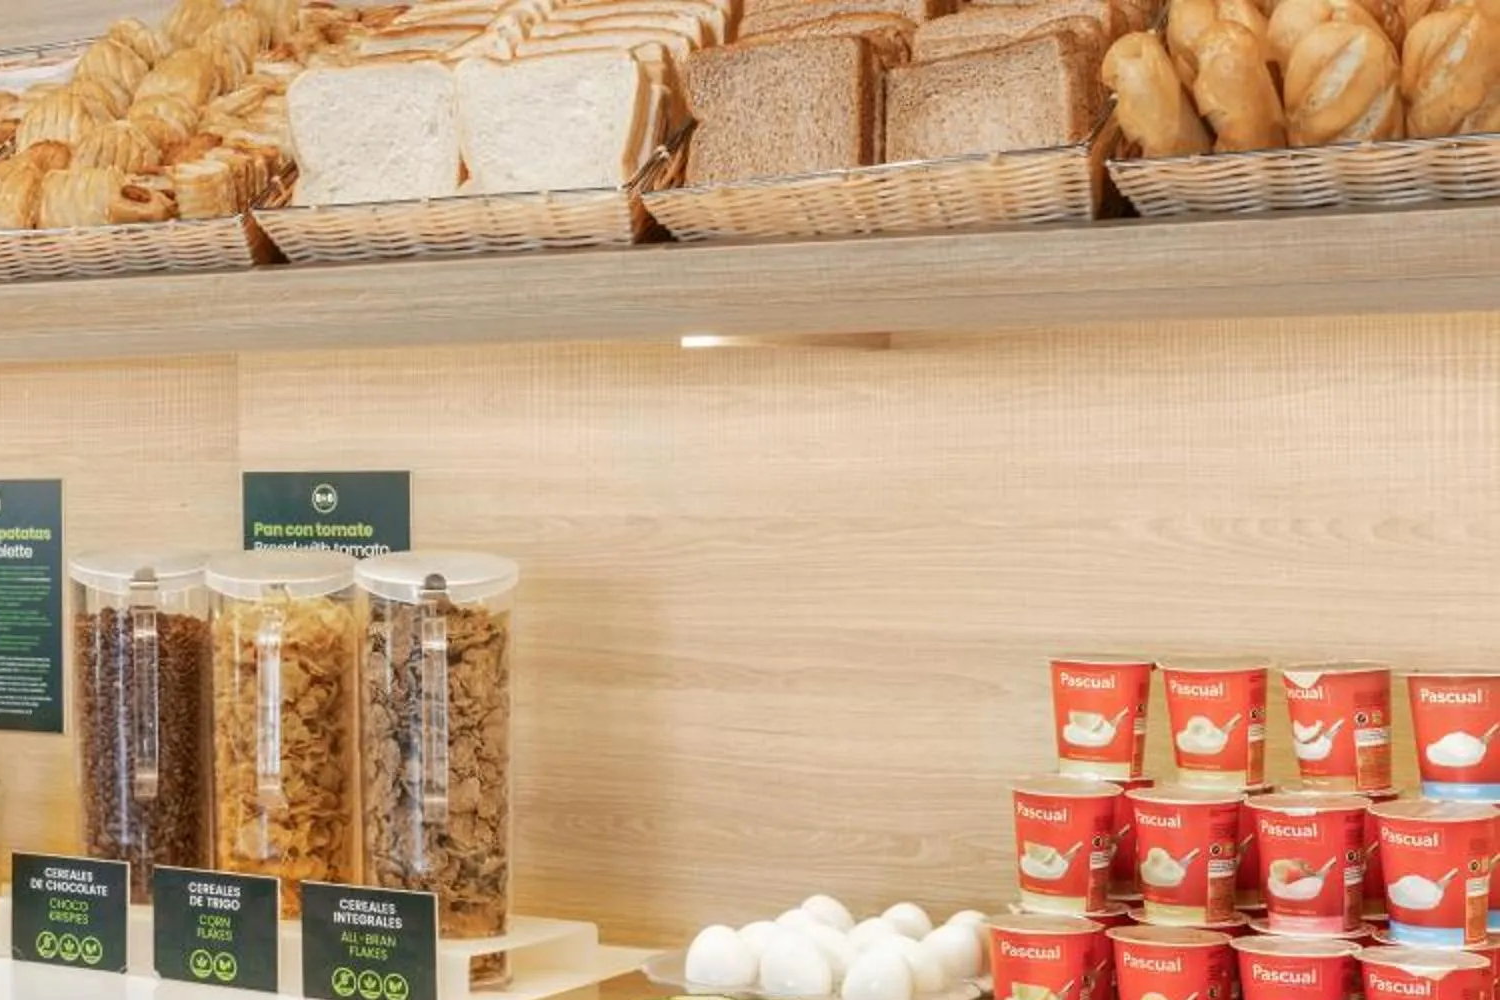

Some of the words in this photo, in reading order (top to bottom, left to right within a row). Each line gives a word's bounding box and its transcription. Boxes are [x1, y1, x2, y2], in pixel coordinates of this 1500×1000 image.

[253, 521, 283, 537] Pan
[285, 525, 314, 537] con
[315, 522, 374, 538] tomate
[1060, 671, 1116, 689] Pascual
[1170, 680, 1224, 697] Pascual
[1420, 688, 1483, 704] Pascual
[1016, 801, 1067, 822] Pascual
[1135, 807, 1181, 829] Pascual
[1260, 819, 1318, 838] Pascual
[1381, 827, 1439, 847] Pascual
[44, 867, 93, 882] CEREALES
[30, 877, 43, 889] DE
[45, 879, 109, 897] CHOCOLATE
[187, 881, 241, 897] CEREALES
[49, 898, 89, 912] CHOCO
[189, 895, 204, 907] DE
[206, 896, 241, 911] TRIGO
[339, 899, 397, 915] CEREALES
[199, 914, 231, 928] CORN
[333, 911, 403, 929] INTEGRALES
[196, 927, 233, 941] FLAKES
[349, 945, 388, 960] FLAKES
[1001, 941, 1061, 960] Pascual
[1123, 952, 1182, 972] Pascual
[1252, 964, 1317, 984] Pascual
[1369, 973, 1431, 996] Pascual
